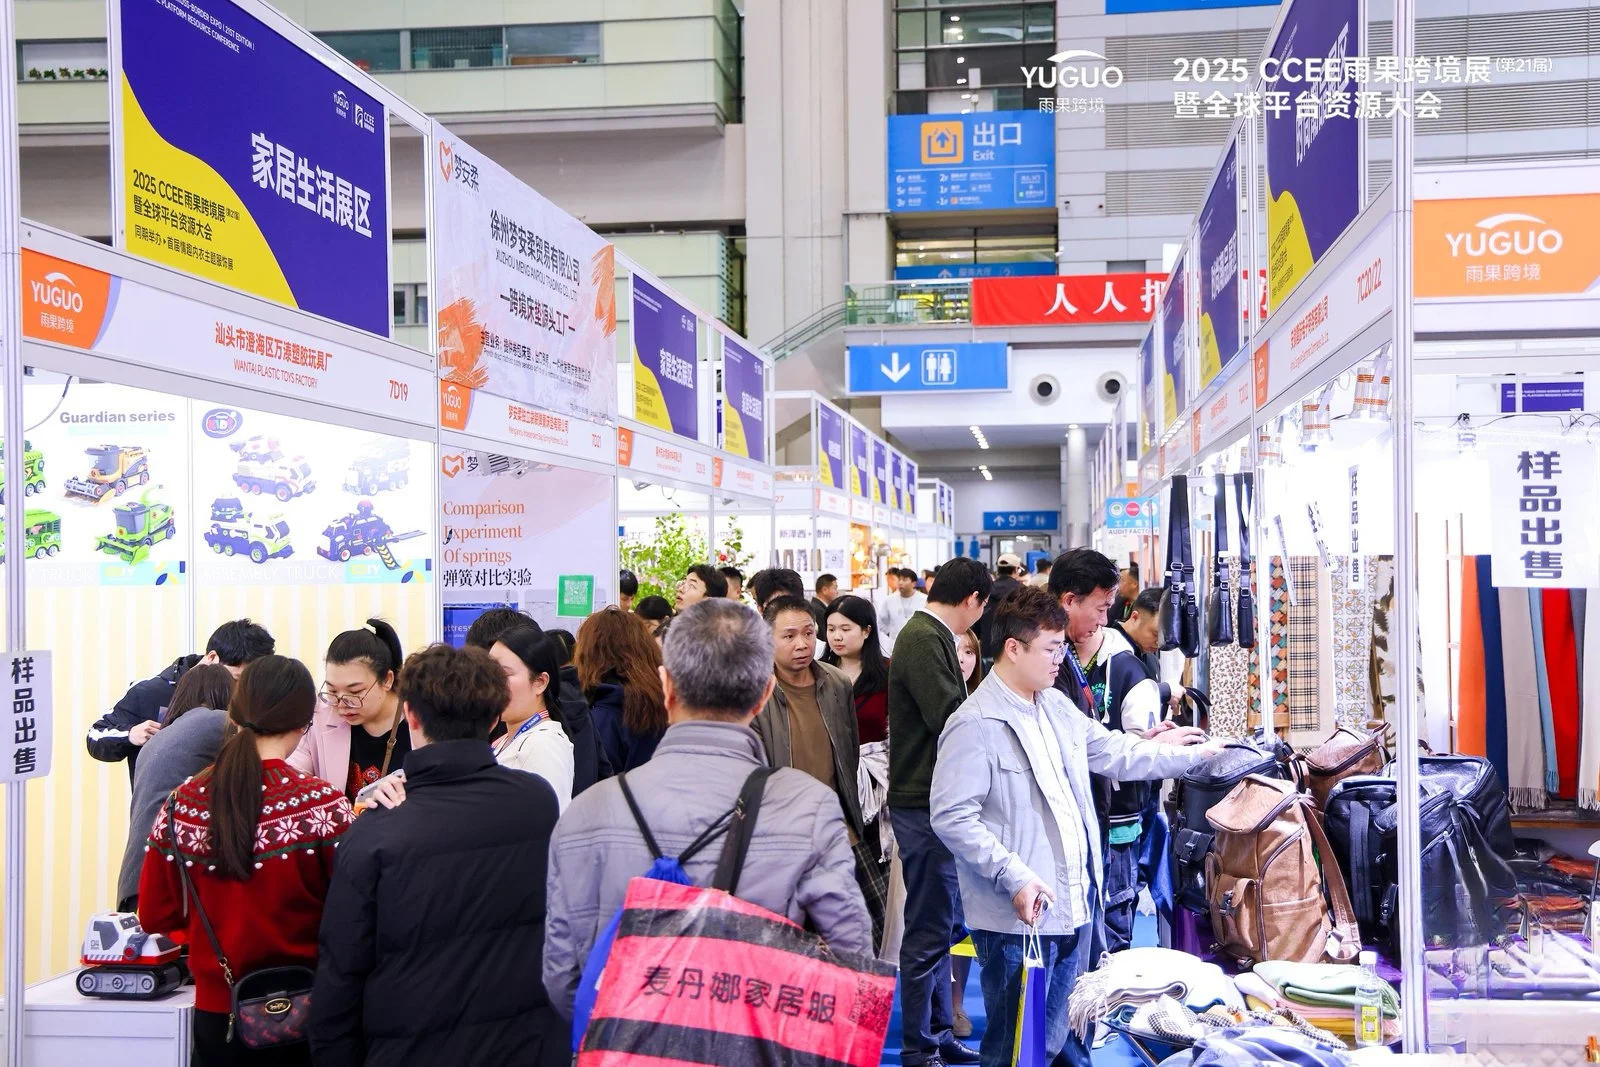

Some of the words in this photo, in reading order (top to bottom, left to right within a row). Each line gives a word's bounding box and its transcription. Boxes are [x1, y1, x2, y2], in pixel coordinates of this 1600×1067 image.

[187, 13, 211, 36] RESOURCE
[212, 30, 240, 53] CONFERENCE
[235, 32, 252, 49] EDITION
[972, 121, 1022, 147] 出口
[973, 150, 995, 161] Exit
[133, 169, 157, 195] 2025
[454, 152, 480, 193] 梦安柔
[251, 132, 372, 239] 家居生活展区
[133, 194, 213, 242] 暨全球平台资源大会
[134, 224, 161, 246] 同期举办
[1445, 229, 1563, 257] YUGUO
[490, 209, 580, 286] 徐州梦安柔贸易有限公司
[1465, 264, 1541, 283] 雨果跨境
[31, 280, 83, 313] YUGUO
[40, 311, 75, 334] 雨果跨境
[233, 358, 257, 374] WANTAI
[257, 363, 281, 379] PLASTIC
[280, 369, 295, 384] TOYS
[295, 372, 318, 389] FACTORY
[389, 380, 409, 402] 7D19
[442, 391, 462, 409] YUGUO
[59, 410, 126, 425] Guardian
[129, 410, 176, 423] series
[443, 499, 525, 519] Comparison
[1008, 514, 1017, 527] 9
[1516, 450, 1563, 579] 样品出售
[443, 524, 523, 543] Experiment
[444, 548, 461, 564] Of
[462, 548, 512, 567] springs
[286, 565, 339, 579] TRUCK
[442, 567, 532, 587] 弹簧对比实验
[11, 656, 37, 775] 样品出售
[641, 965, 836, 1025] 麦丹娜家居服
